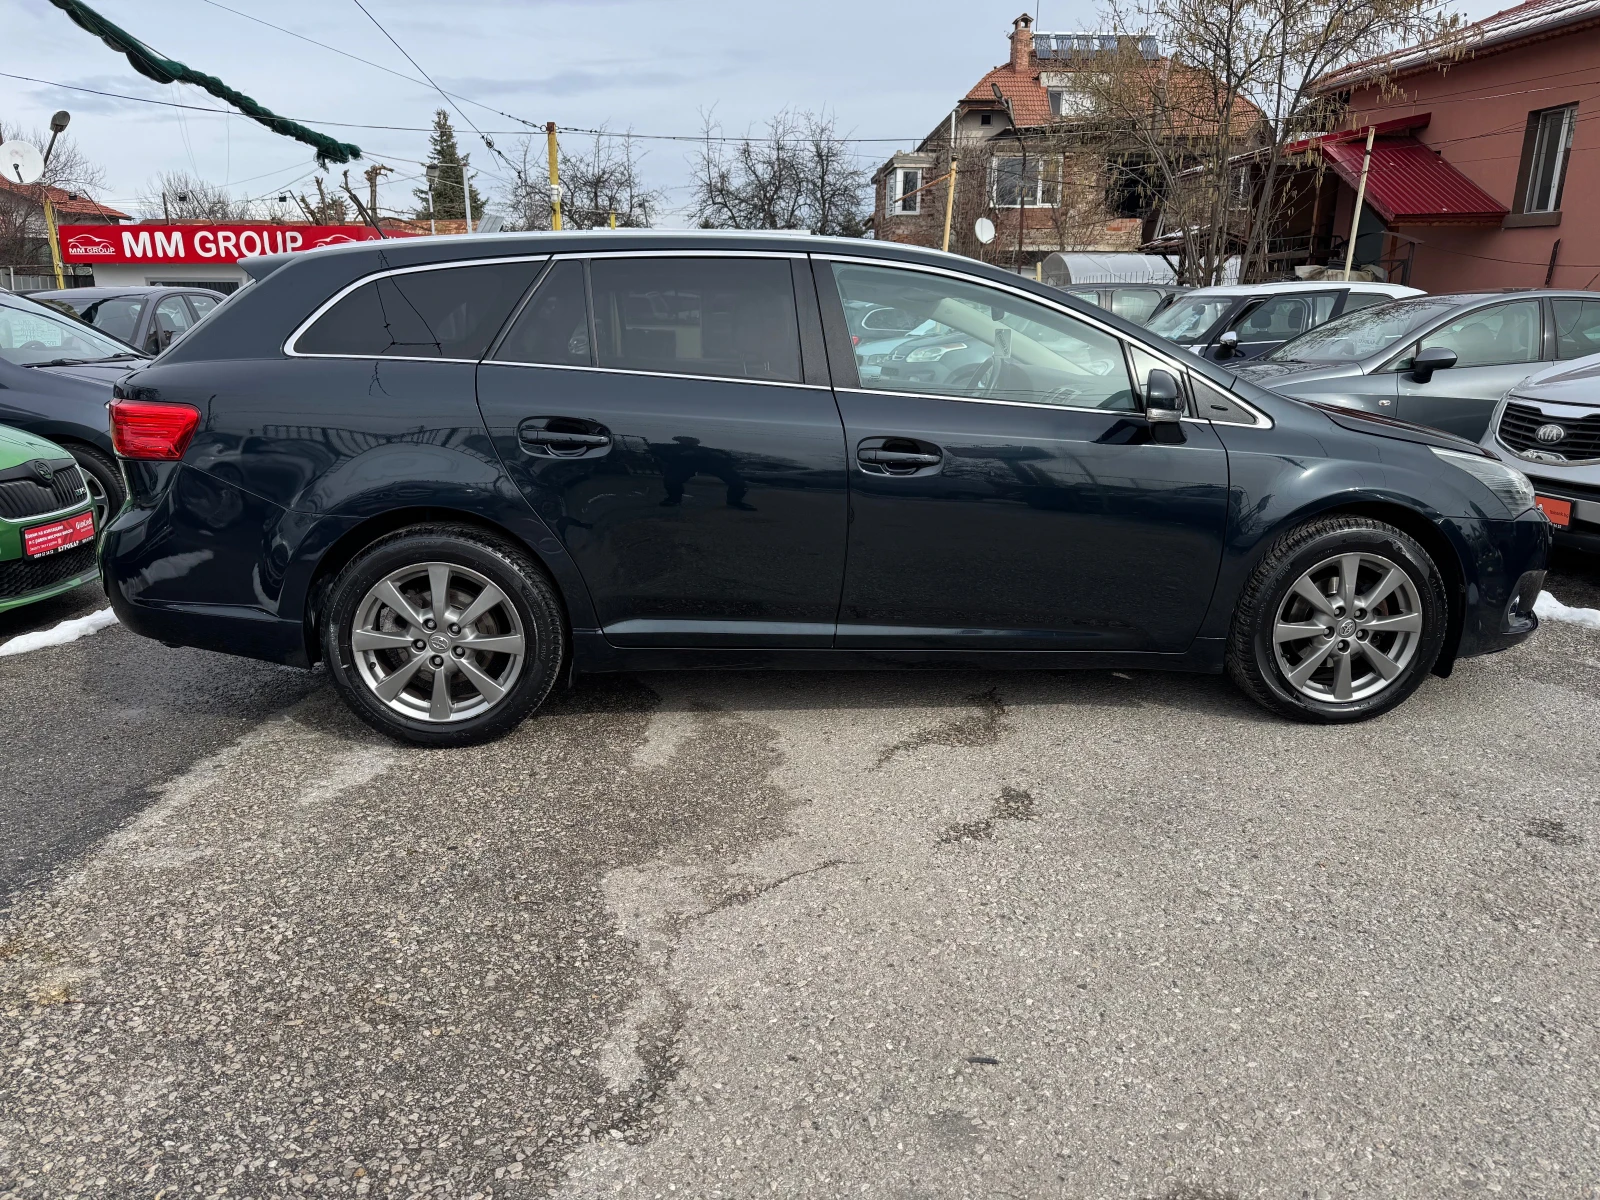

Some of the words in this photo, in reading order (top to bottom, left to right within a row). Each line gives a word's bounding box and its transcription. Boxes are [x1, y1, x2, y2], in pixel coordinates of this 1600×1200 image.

[121, 231, 186, 258] MM
[193, 231, 303, 257] GROUP
[1538, 427, 1557, 440] KIA
